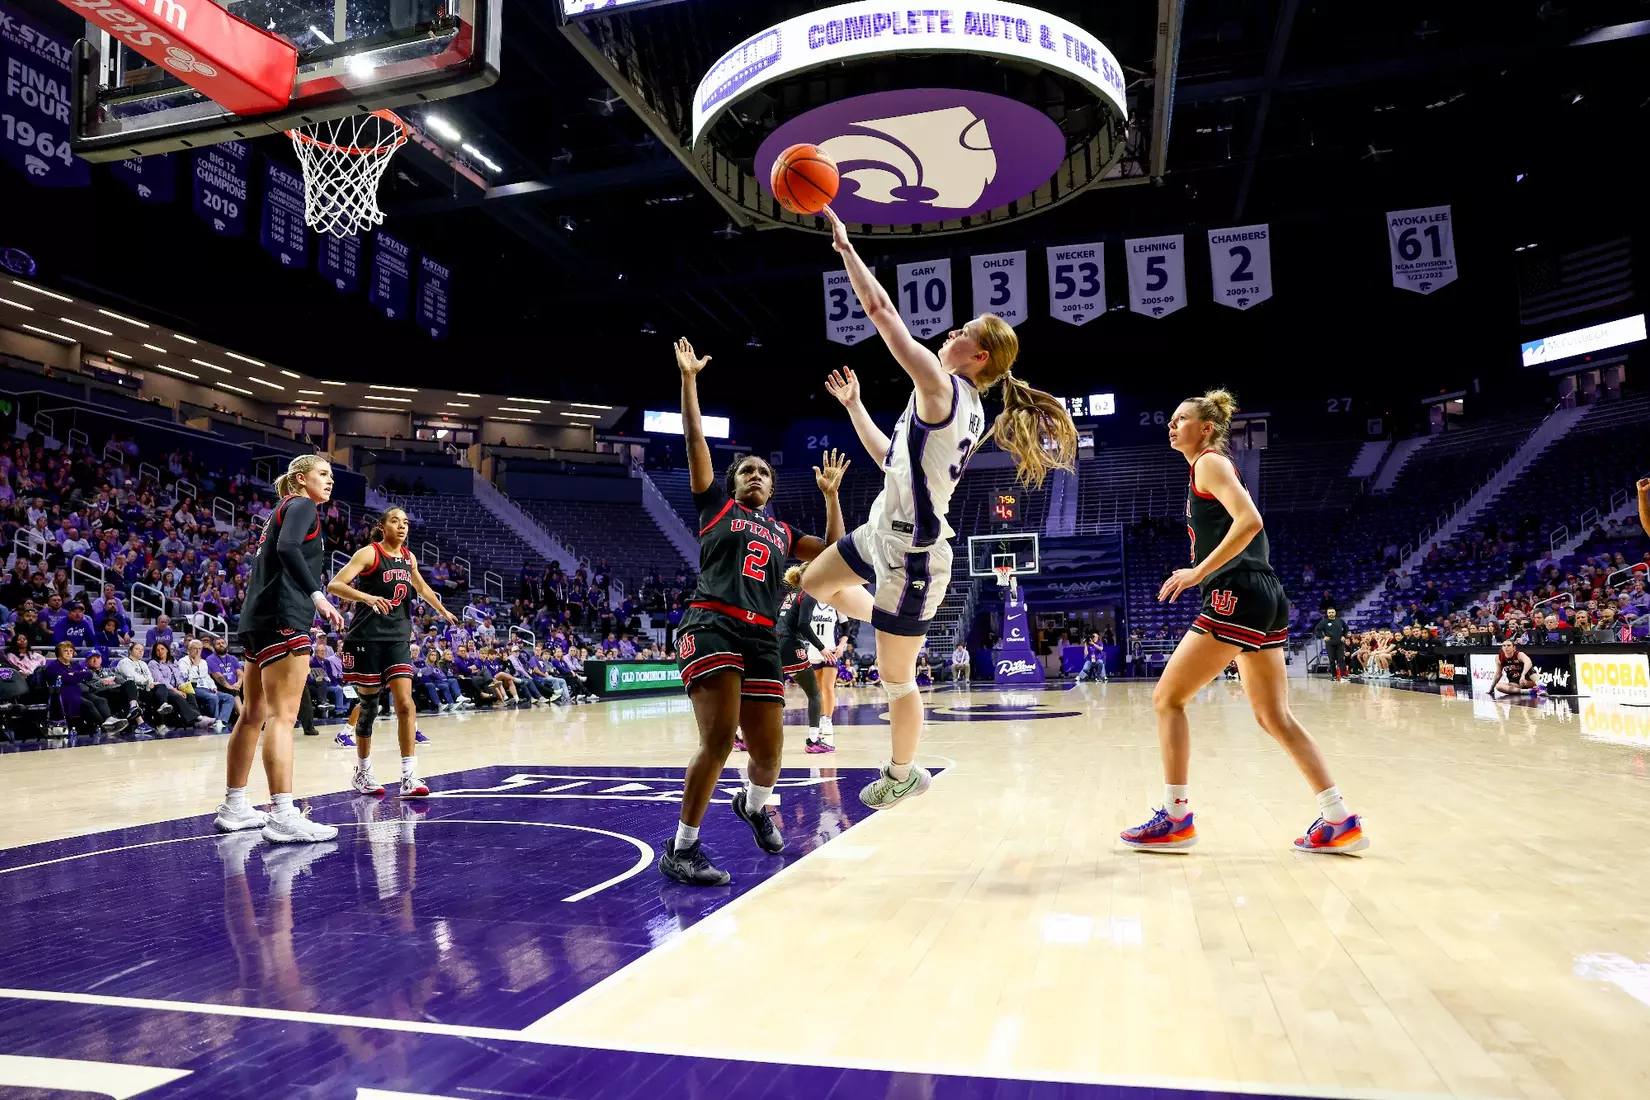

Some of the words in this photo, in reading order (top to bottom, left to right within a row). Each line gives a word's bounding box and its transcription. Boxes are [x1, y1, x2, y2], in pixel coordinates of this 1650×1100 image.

[0, 11, 73, 63] K-STAT
[808, 10, 955, 50] COMPLETE
[964, 11, 1031, 43] AUTO
[1039, 25, 1056, 52] &
[1063, 33, 1098, 74] TIRE
[29, 46, 72, 72] BASKETBA
[8, 57, 71, 107] FINAL
[7, 77, 70, 125] FOUR
[2, 114, 73, 167] 1964
[123, 160, 142, 174] 2018
[197, 157, 247, 189] CONFERENCE
[209, 151, 224, 167] BIG
[226, 161, 236, 174] 12
[196, 166, 247, 200] CHAMPIONS
[269, 166, 305, 192] K-STAT
[203, 189, 238, 218] 2019
[1392, 216, 1428, 226] AYOKA
[1429, 212, 1448, 222] LEE
[377, 232, 408, 256] K-STATE
[1133, 242, 1176, 253] LEHNING
[1212, 231, 1266, 244] CHAMBERS
[1398, 225, 1442, 261] 61
[422, 256, 450, 277] K-STATE
[983, 258, 1014, 268] OHLDE
[1056, 250, 1095, 260] WECKER
[1228, 246, 1254, 282] 2
[1416, 260, 1446, 268] DIVISION
[912, 266, 936, 276] GARY
[1054, 262, 1100, 300] 53
[1146, 256, 1168, 292] 5
[1408, 272, 1443, 280] 1/23/2022
[903, 278, 946, 314] 10
[990, 271, 1010, 306] 3
[1142, 296, 1174, 304] 2005-09
[1226, 286, 1260, 296] 2009-13
[1062, 303, 1094, 312] 2001-05
[836, 324, 865, 333] 1979-82
[911, 317, 942, 326] 1981-83
[1326, 398, 1352, 412] 27
[1140, 412, 1164, 426] 26
[807, 435, 830, 449] 24
[731, 519, 784, 555] UTAH
[742, 540, 771, 582] 2
[391, 583, 407, 606] 0
[816, 624, 824, 635] 11
[622, 672, 635, 683] OLD
[636, 670, 666, 682] DOMINION
[1553, 667, 1570, 688] Hut
[1581, 662, 1648, 692] QDOBA
